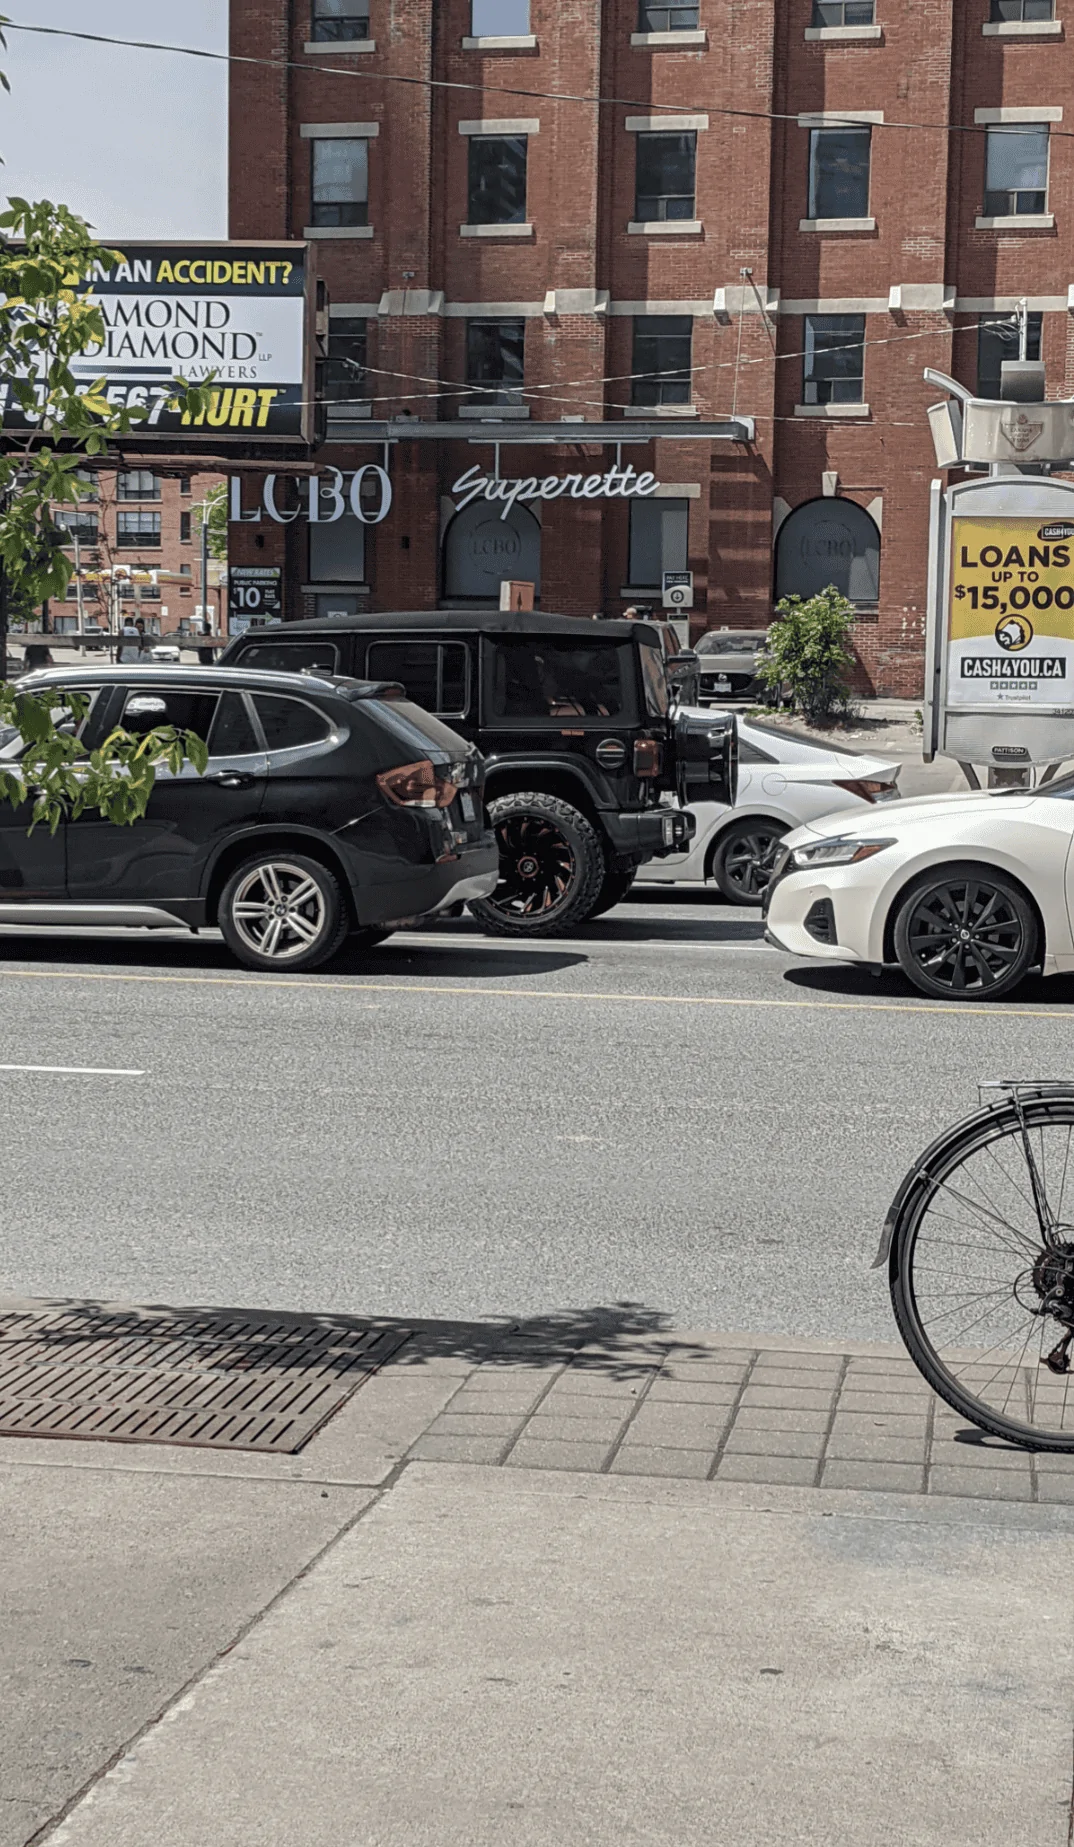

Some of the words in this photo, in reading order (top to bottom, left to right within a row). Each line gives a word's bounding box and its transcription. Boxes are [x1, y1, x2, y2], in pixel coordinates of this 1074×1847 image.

[114, 259, 152, 283] AN
[156, 260, 293, 285] ACCIDENT?
[258, 353, 273, 362] LLP
[178, 365, 258, 379] LAWYERS
[228, 464, 393, 524] LCBO
[451, 463, 661, 521] Superette
[961, 545, 1071, 568] LOANS
[991, 571, 1013, 582] UP
[1017, 571, 1040, 582] TO
[954, 584, 1074, 615] $15,000
[963, 658, 1063, 677] CASH4YOU.CA
